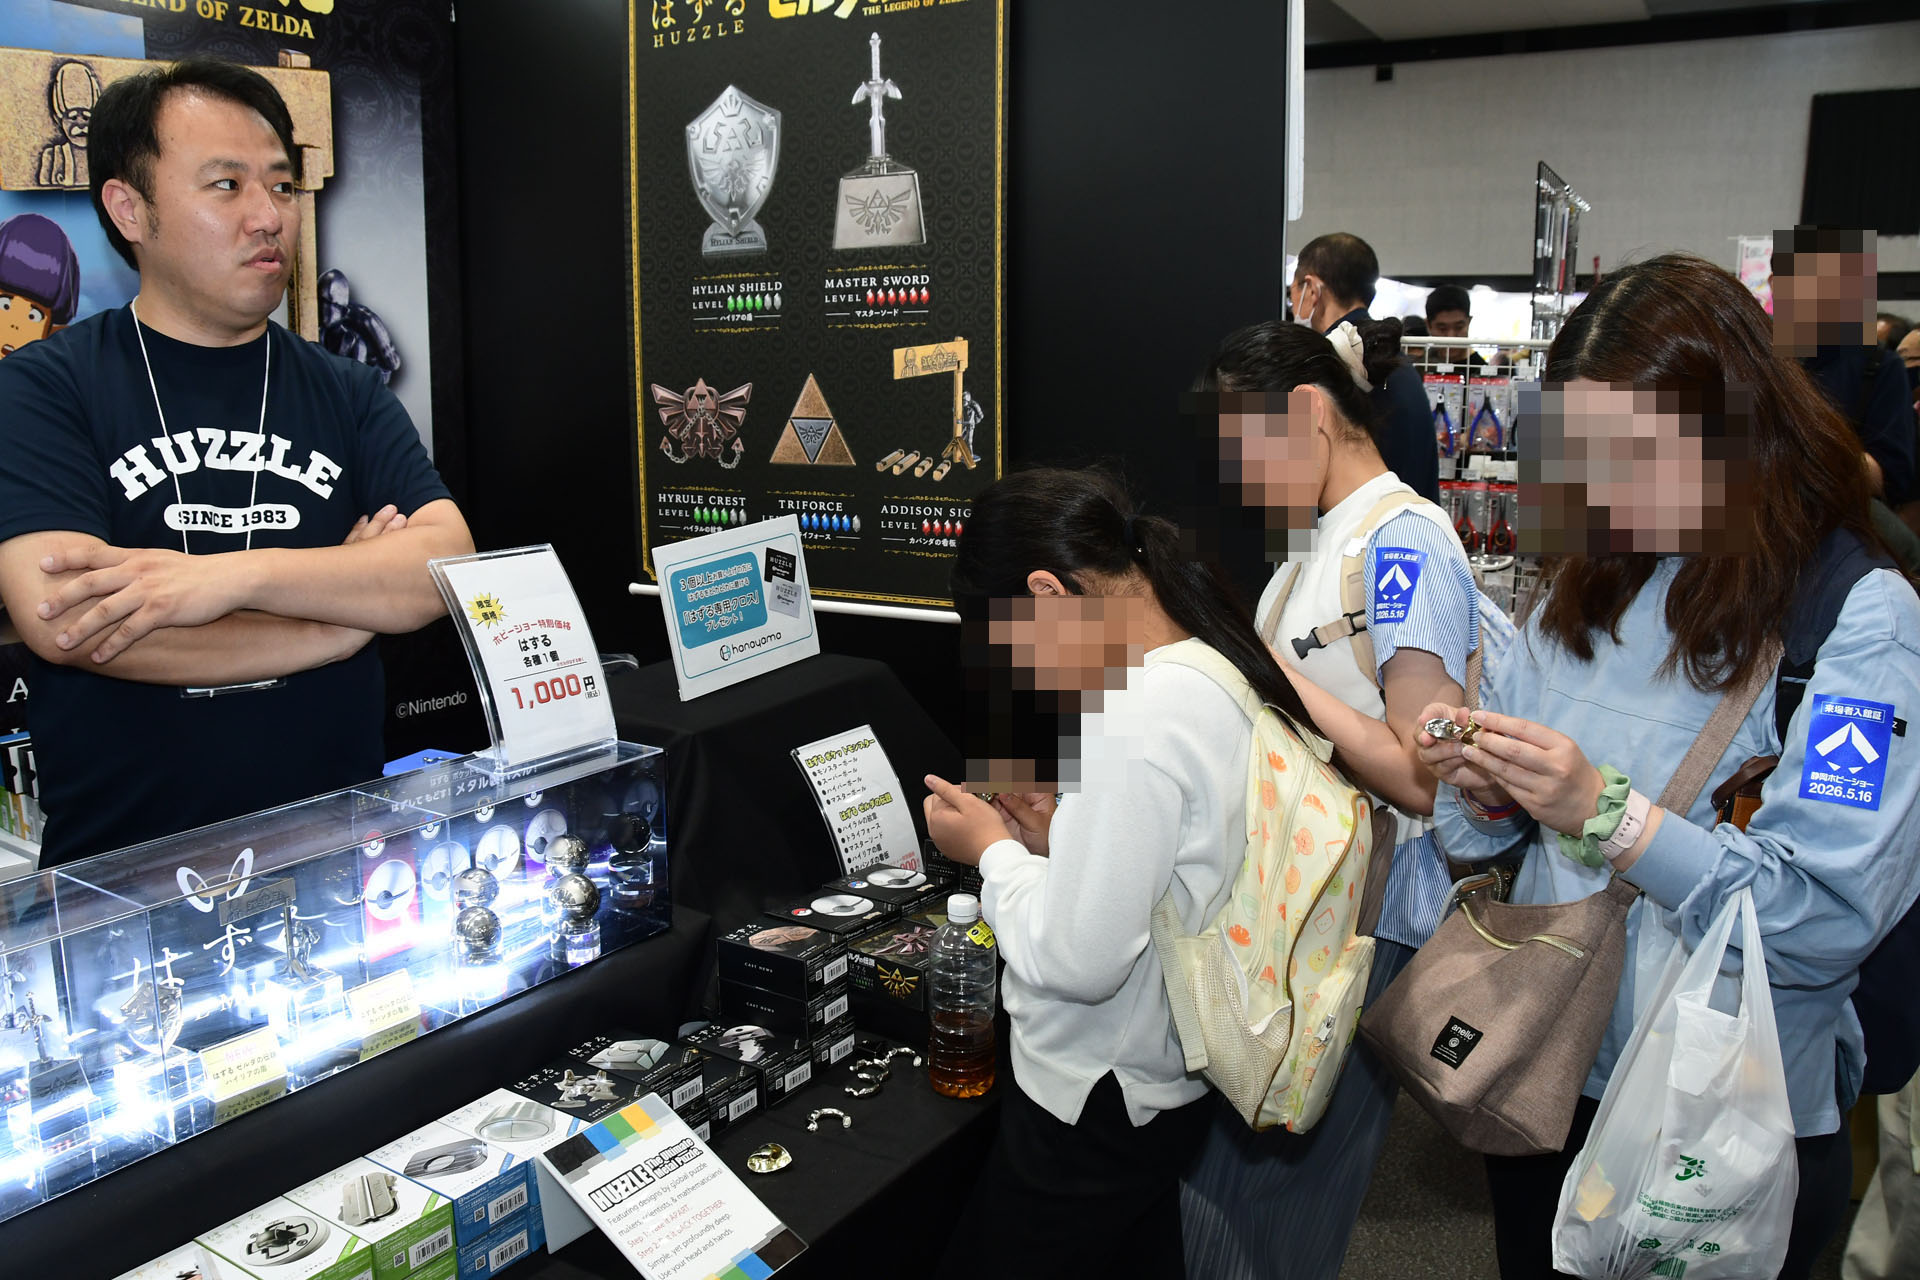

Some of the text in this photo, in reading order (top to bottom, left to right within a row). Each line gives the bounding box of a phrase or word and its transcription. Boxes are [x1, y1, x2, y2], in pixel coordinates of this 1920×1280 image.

[862, 5, 881, 16] THE
[884, 0, 920, 13] LEGEND
[196, 0, 228, 21] OF
[239, 6, 315, 39] ZELDA
[653, 19, 744, 48] HUZZLE
[692, 281, 782, 295] HYLIAN SHIELD
[824, 274, 930, 288] MASTER SWORD
[692, 300, 723, 310] LEVEL
[824, 293, 861, 303] LEVEL
[855, 308, 899, 317] マスターソード
[109, 427, 343, 501] HUZZLE
[658, 493, 746, 507] HYRULE CREST
[778, 499, 843, 511] TRIFORCE
[178, 509, 287, 528] SINCE 1983
[658, 508, 690, 518] LEVEL
[880, 504, 972, 518] ADDISON SIG
[880, 521, 917, 530] LEVEL
[799, 531, 831, 540] イフォース
[909, 537, 957, 547] カバンダの看板
[476, 599, 493, 609] 限定
[683, 589, 759, 626] 「はずる専用クロス」
[481, 610, 498, 621] 価格
[518, 634, 552, 652] はずる
[732, 632, 782, 655] hanayama
[522, 650, 560, 668] 各種1個
[395, 691, 467, 719] ©Nintendo
[1824, 703, 1882, 721] 来場者入館証
[805, 738, 876, 768] はずる ポケットモンスター
[817, 757, 858, 775] モンスターボール
[1810, 771, 1875, 789] 静岡ホビーショー
[830, 786, 867, 803] マスターボール
[1808, 782, 1872, 803] 2026.5.16
[839, 806, 858, 821] はずる
[846, 823, 880, 842] トライフォース
[849, 832, 883, 851] マスターソード
[213, 1067, 234, 1080] はずる
[514, 1068, 554, 1089] はずる
[644, 1137, 694, 1171] The Ultimate
[652, 1158, 680, 1179] Metal
[588, 1164, 656, 1212] HUZZLE
[608, 1162, 708, 1226] Featuring designs by global puzzle
[642, 1200, 673, 1220] ientists,
[676, 1167, 723, 1200] mathematicians!
[627, 1235, 644, 1248] Step
[647, 1251, 674, 1271] Simple,
[672, 1244, 684, 1256] yet
[682, 1224, 716, 1248] profoundly
[637, 1245, 654, 1259] Step
[658, 1268, 672, 1280] Use
[672, 1260, 687, 1273] your
[687, 1247, 703, 1264] head
[702, 1240, 716, 1252] and
